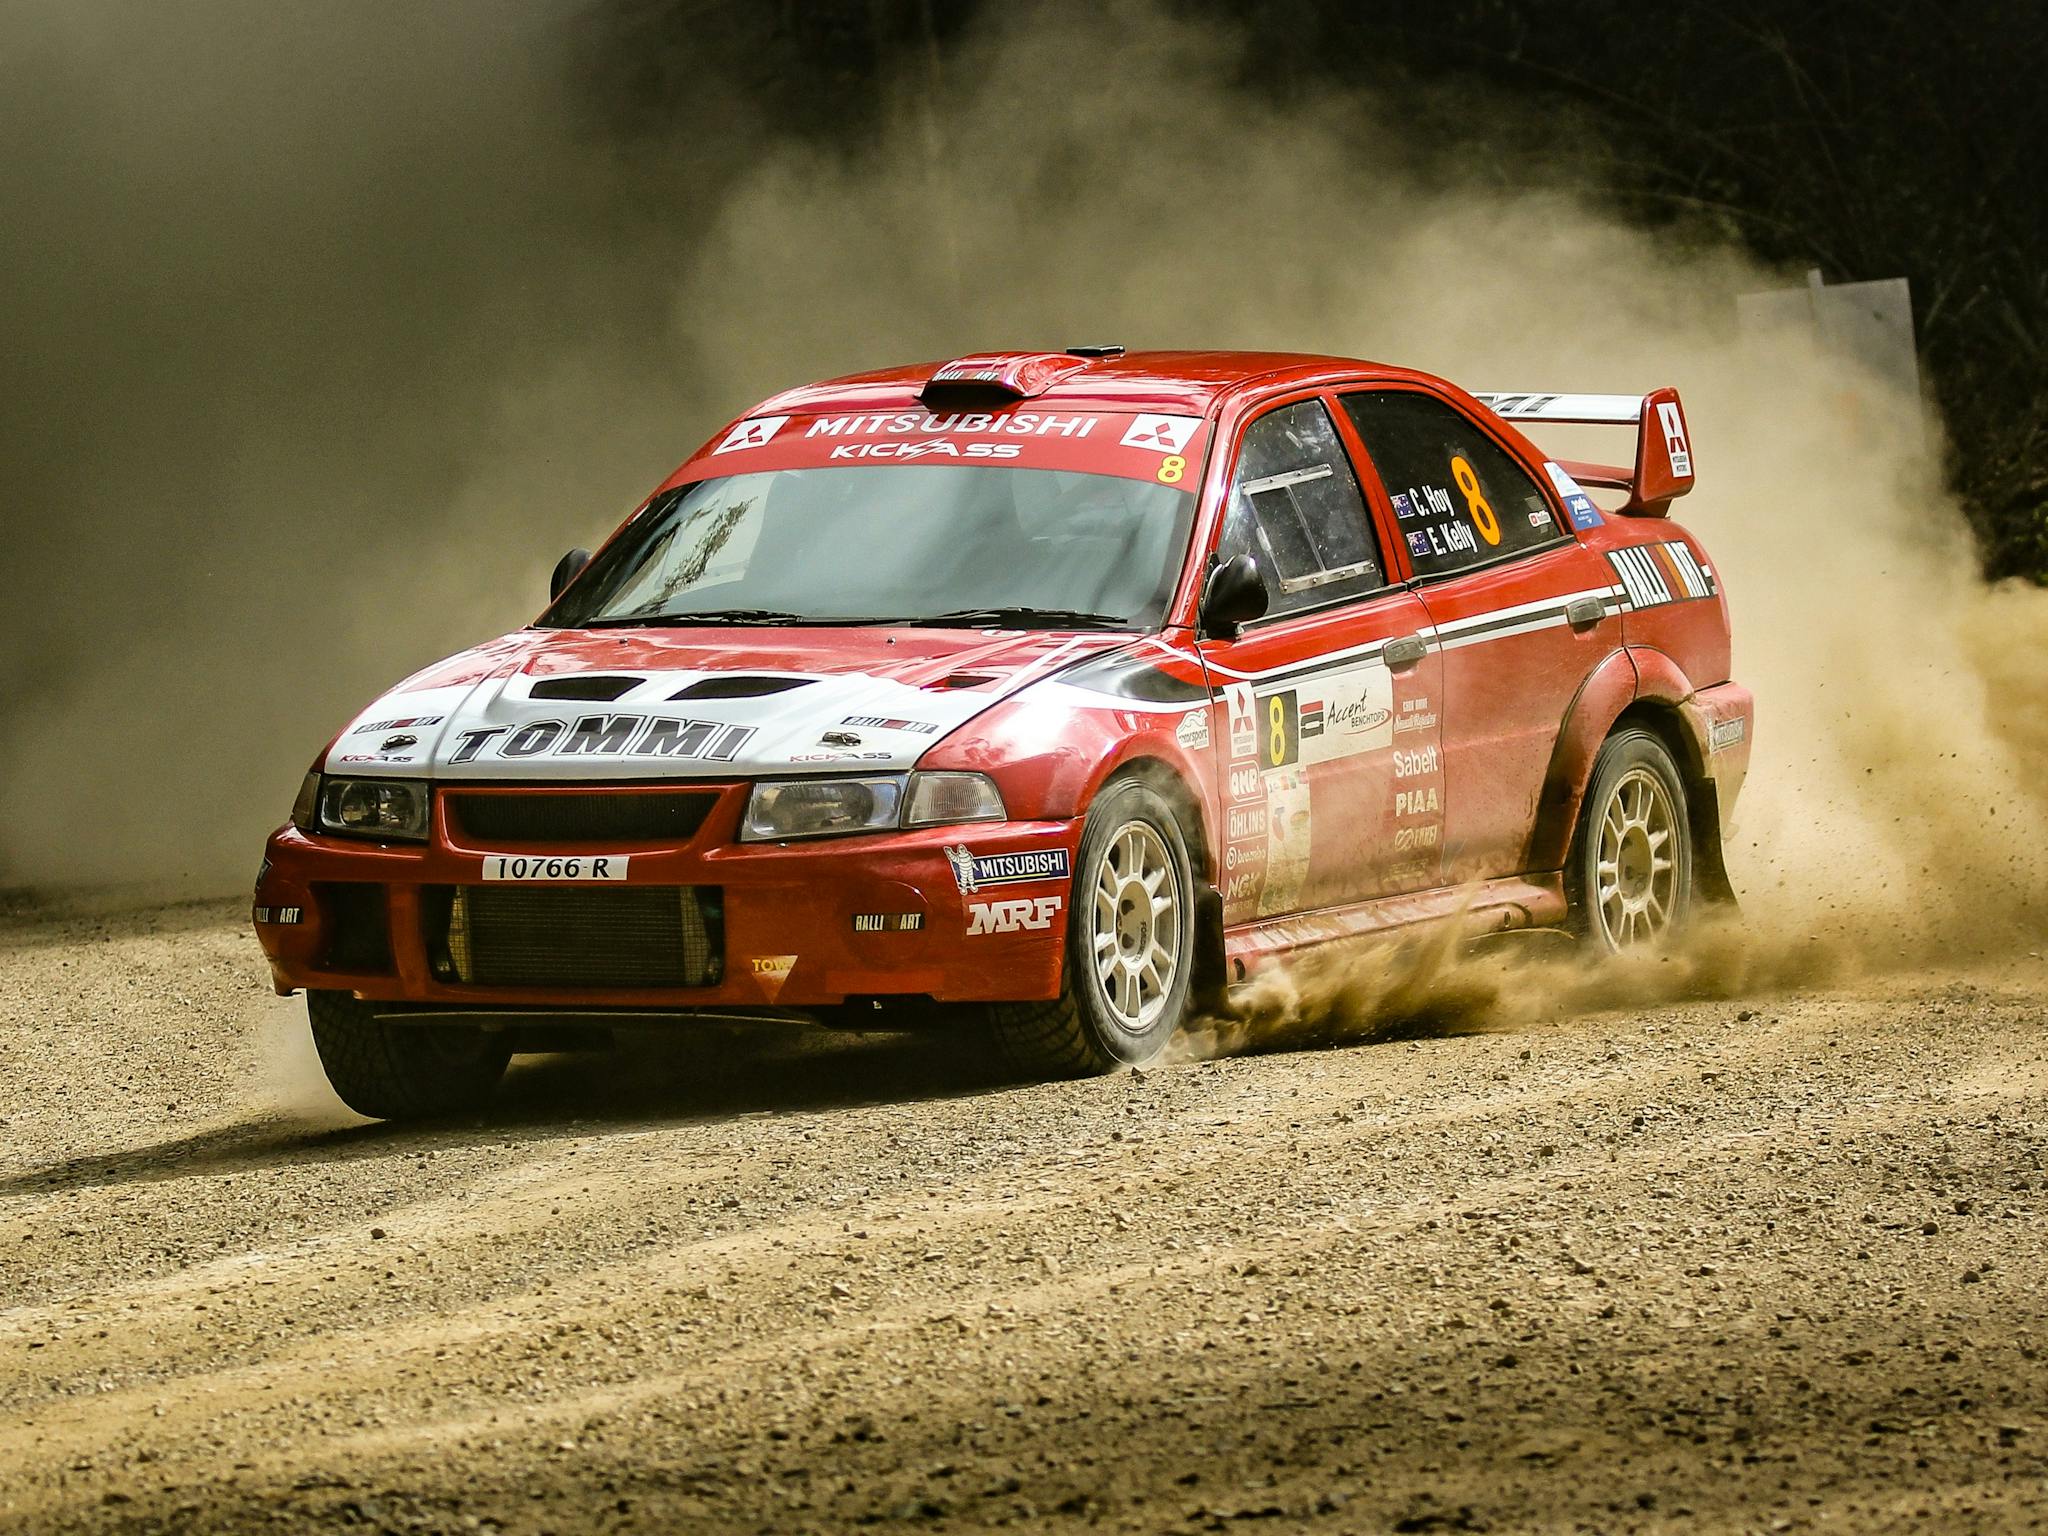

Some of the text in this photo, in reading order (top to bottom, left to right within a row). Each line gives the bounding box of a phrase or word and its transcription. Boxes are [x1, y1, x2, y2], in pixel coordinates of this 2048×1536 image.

[804, 412, 1098, 440] MITSUBISHI
[1157, 456, 1186, 484] 8
[1408, 485, 1455, 517] C. Hoy
[1451, 456, 1500, 546] 8
[1426, 520, 1478, 555] E. Kelly
[1326, 688, 1367, 728] Accent
[1351, 711, 1385, 728] BENCHTOPS
[447, 713, 763, 765] TOMMI
[1269, 695, 1287, 766] 8
[1393, 745, 1438, 778] Sabelt
[1395, 788, 1439, 817] PIAA
[1230, 808, 1266, 838] ÖHLINS
[499, 857, 611, 879] 10766 R
[979, 852, 1065, 879] MITSUBISHI
[280, 907, 300, 923] ART
[855, 913, 922, 931] RALLI ART
[966, 896, 1062, 936] MRF
